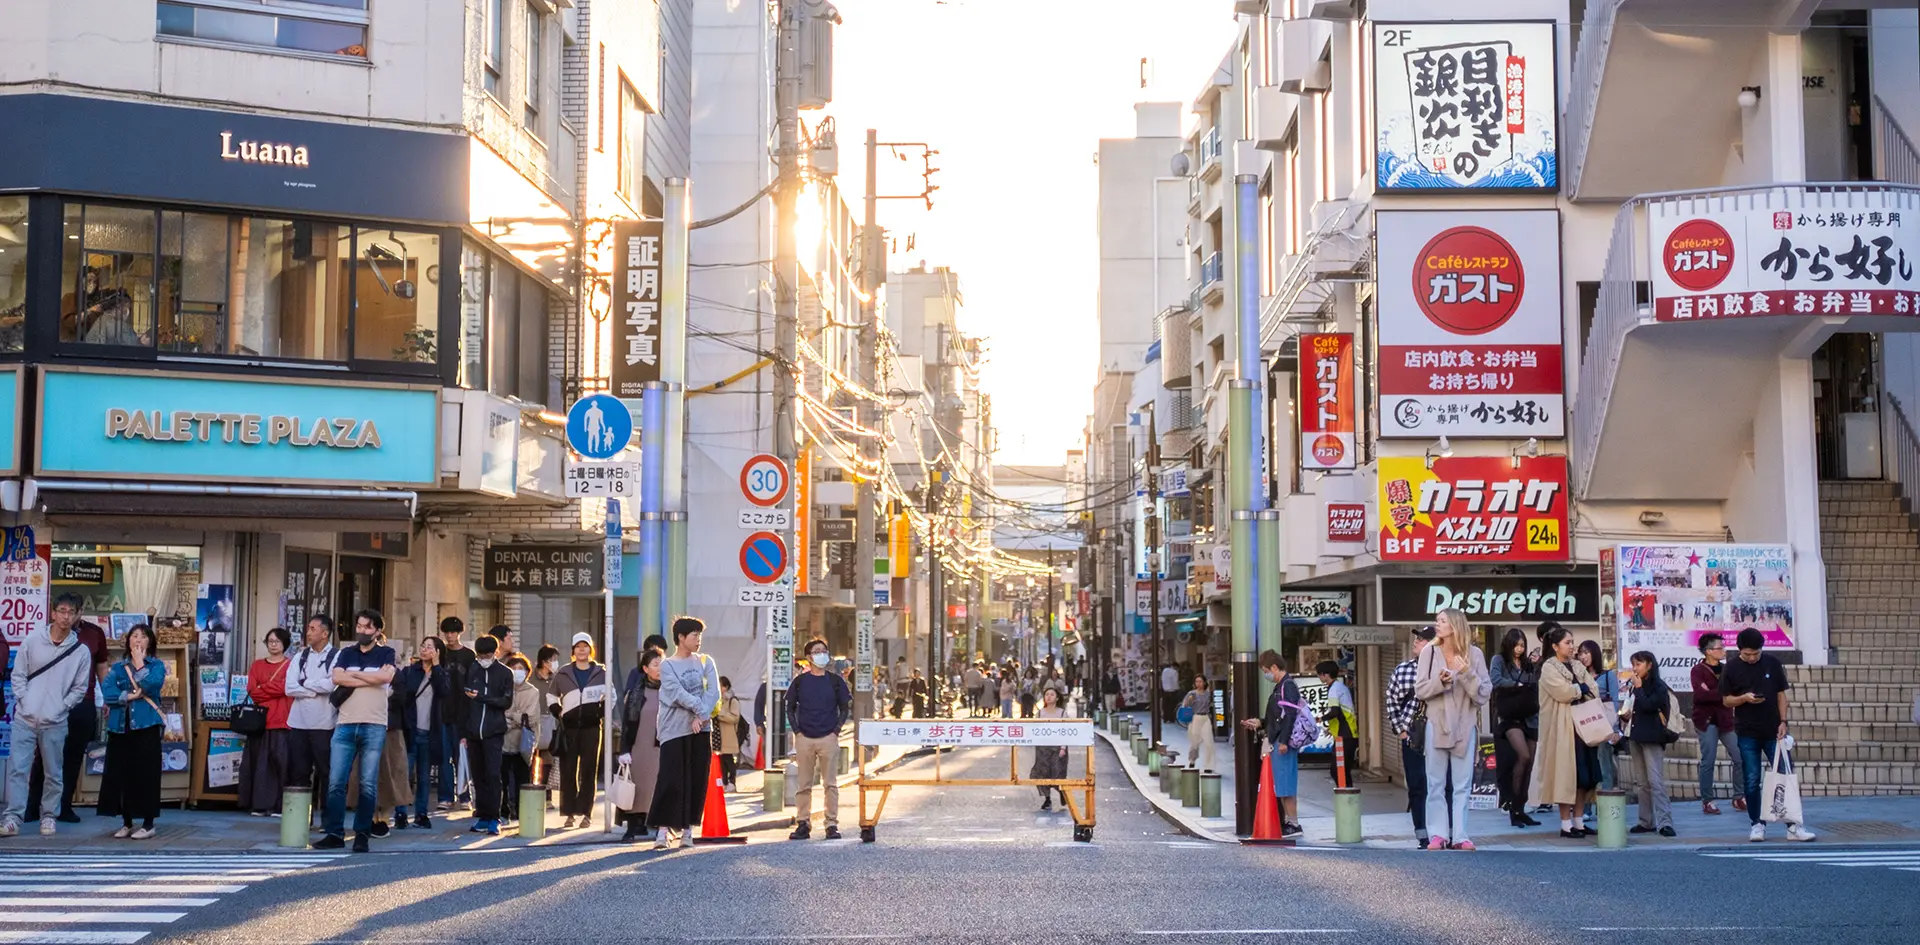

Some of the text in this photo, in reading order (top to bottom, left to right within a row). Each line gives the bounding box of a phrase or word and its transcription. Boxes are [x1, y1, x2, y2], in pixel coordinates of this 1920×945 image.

[1383, 30, 1412, 47] 2F
[1802, 75, 1825, 88] ISE
[1412, 51, 1461, 141] 銀次
[1453, 47, 1504, 178] 目利きの
[220, 131, 309, 166] Luana
[1797, 212, 1901, 228] から揚げ専門
[1673, 249, 1728, 273] ガスト
[1760, 234, 1913, 286] から好し
[1428, 272, 1515, 304] ガスト
[625, 236, 659, 367] 証明写真
[1314, 336, 1339, 348] Café
[1404, 350, 1538, 368] 店内飲食・お弁当
[1428, 372, 1514, 390] お持ち帰り
[1315, 357, 1339, 430] ガスト
[1470, 400, 1549, 426] から好し
[105, 407, 383, 449] PALETTE PLAZA
[1315, 448, 1341, 457] ガスト
[751, 469, 778, 492] 30
[1385, 479, 1414, 529] 爆安
[1417, 479, 1560, 514] カラオケ
[741, 513, 787, 524] ここから
[1329, 509, 1364, 518] カラオケ
[1329, 518, 1364, 529] ベスト10
[1436, 516, 1519, 541] ベスト10
[1529, 524, 1558, 545] 24h
[15, 549, 30, 559] OFF
[1386, 538, 1425, 554] B1F
[1435, 544, 1511, 555] ヒットパレード
[494, 551, 593, 564] DENTAL CLINIC
[4, 561, 42, 573] 年賀状
[495, 567, 592, 586] 山本歯科医院
[82, 595, 124, 612] AZA
[740, 591, 785, 602] ここから
[1426, 585, 1577, 615] Dr.stretch
[1, 598, 44, 621] 20%
[7, 622, 36, 637] OFF
[928, 725, 1024, 738] 歩行者天国
